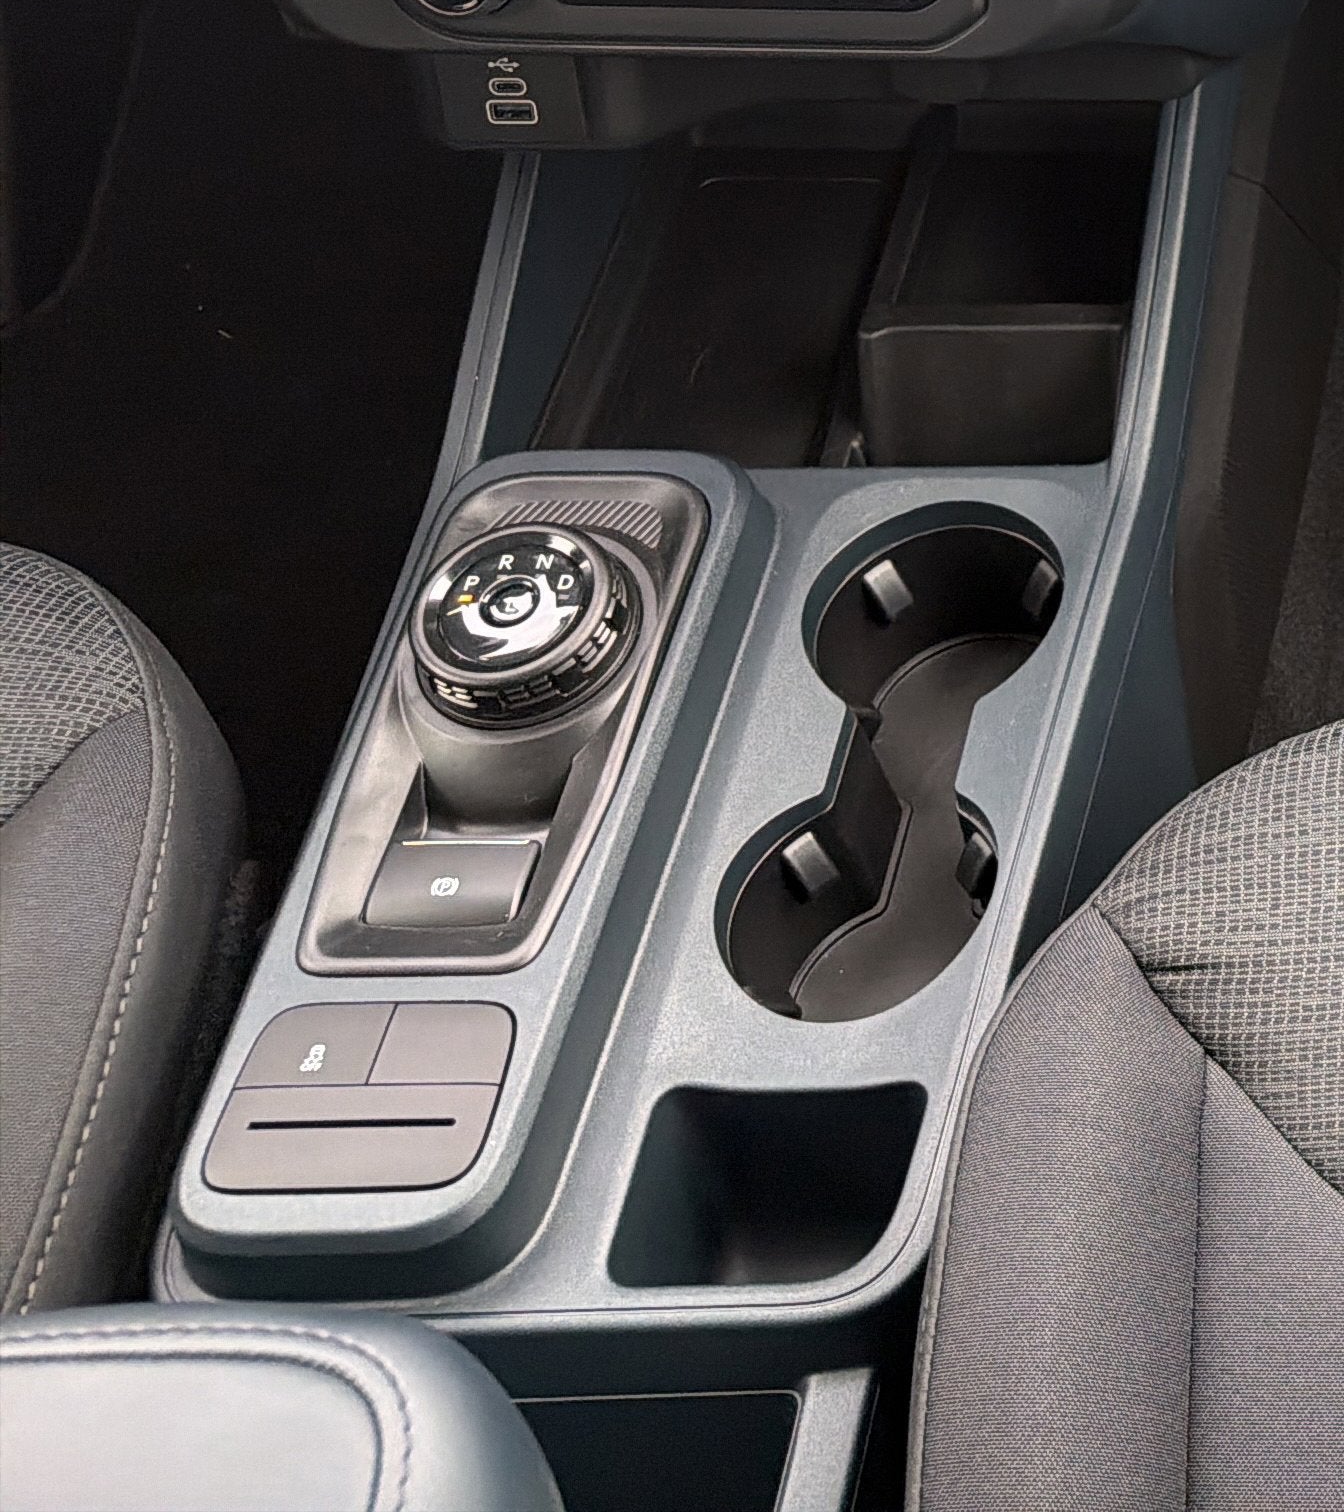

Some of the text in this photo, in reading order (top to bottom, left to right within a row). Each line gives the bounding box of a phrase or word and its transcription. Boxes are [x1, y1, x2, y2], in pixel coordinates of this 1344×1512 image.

[498, 554, 514, 570] R
[535, 553, 554, 570] N
[464, 576, 480, 591] P
[557, 575, 575, 591] D
